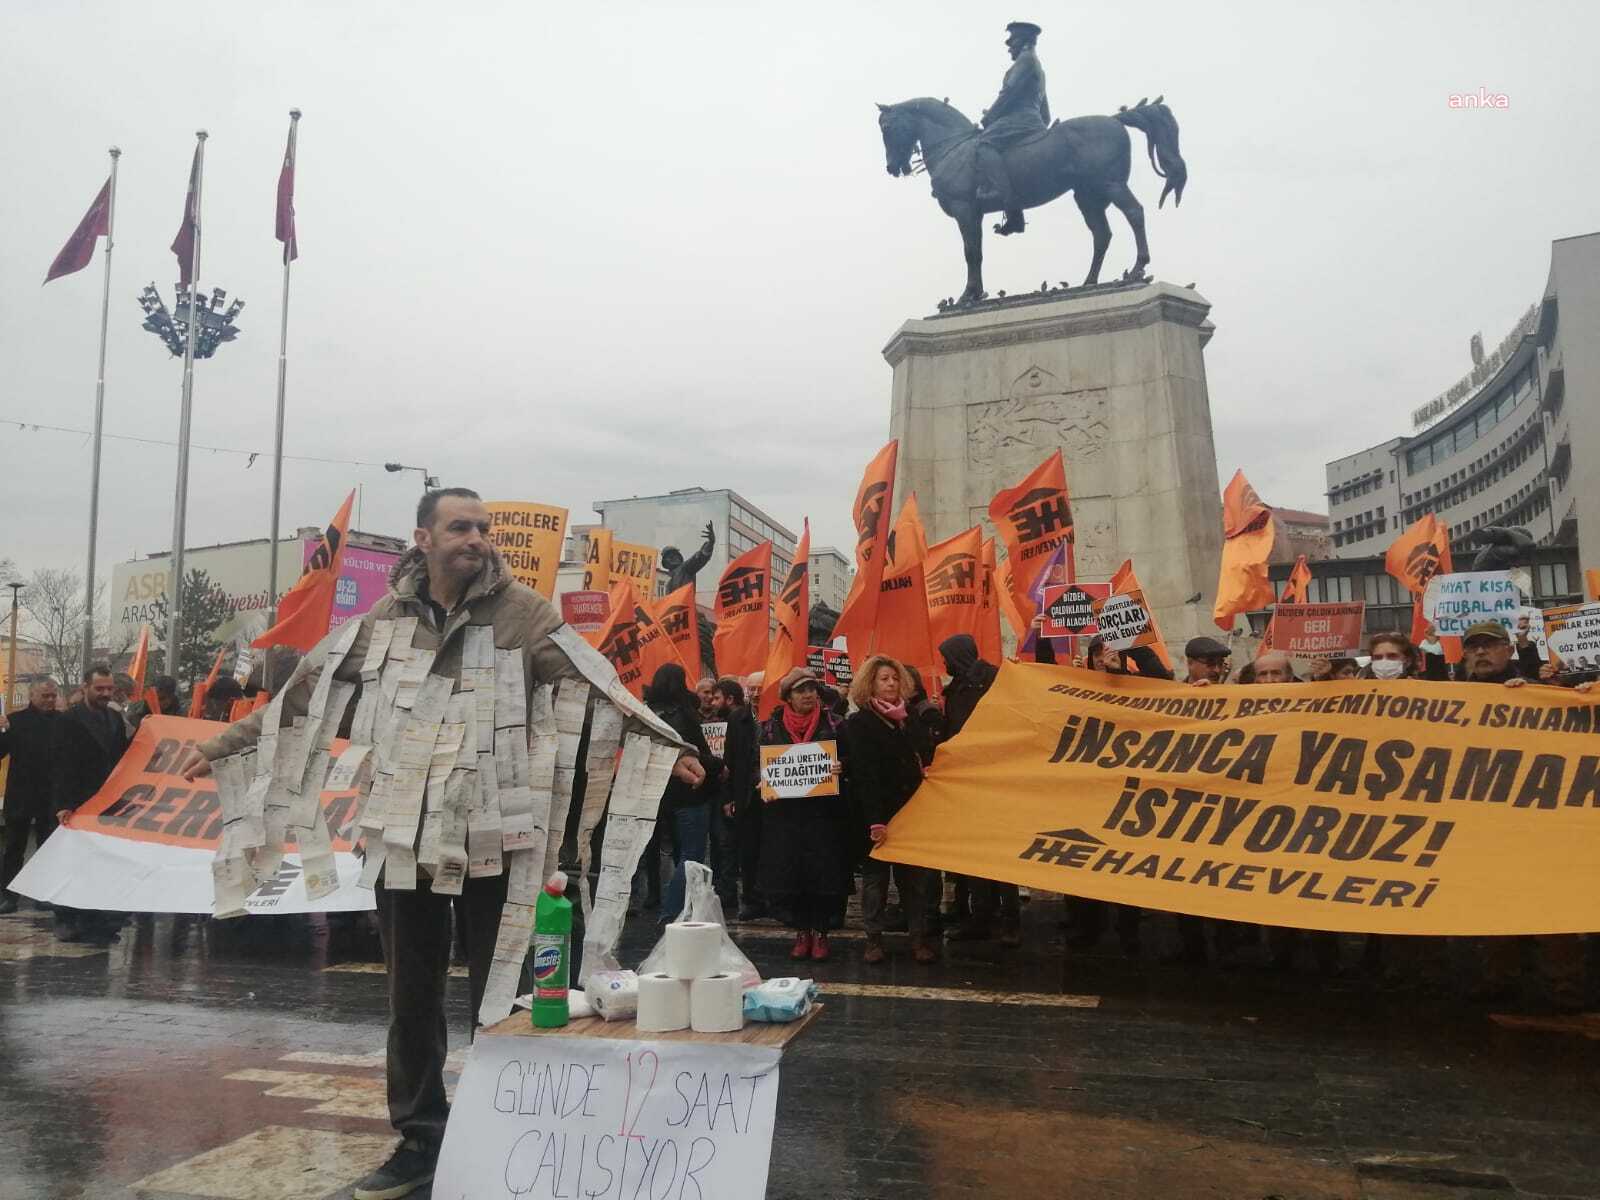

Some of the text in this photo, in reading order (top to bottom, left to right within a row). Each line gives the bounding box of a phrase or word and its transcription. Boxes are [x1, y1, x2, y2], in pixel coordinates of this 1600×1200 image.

[127, 570, 174, 602] ASB
[1304, 616, 1331, 633] GERİ
[1577, 640, 1600, 650] KOYA
[1048, 683, 1229, 722] BARINAMIYORUZ,
[1478, 702, 1600, 734] ISINAMI
[767, 764, 832, 779] VE DAĞITIMI
[1048, 714, 1600, 810] İNSANCA YAŞAMAK
[1102, 776, 1456, 868] İSTİYORUZ!
[1091, 848, 1441, 908] HALKEVLERİ
[494, 1050, 768, 1142] GÜNDE 12 SAAT
[504, 1128, 716, 1200] ÇALIŞIYOR
